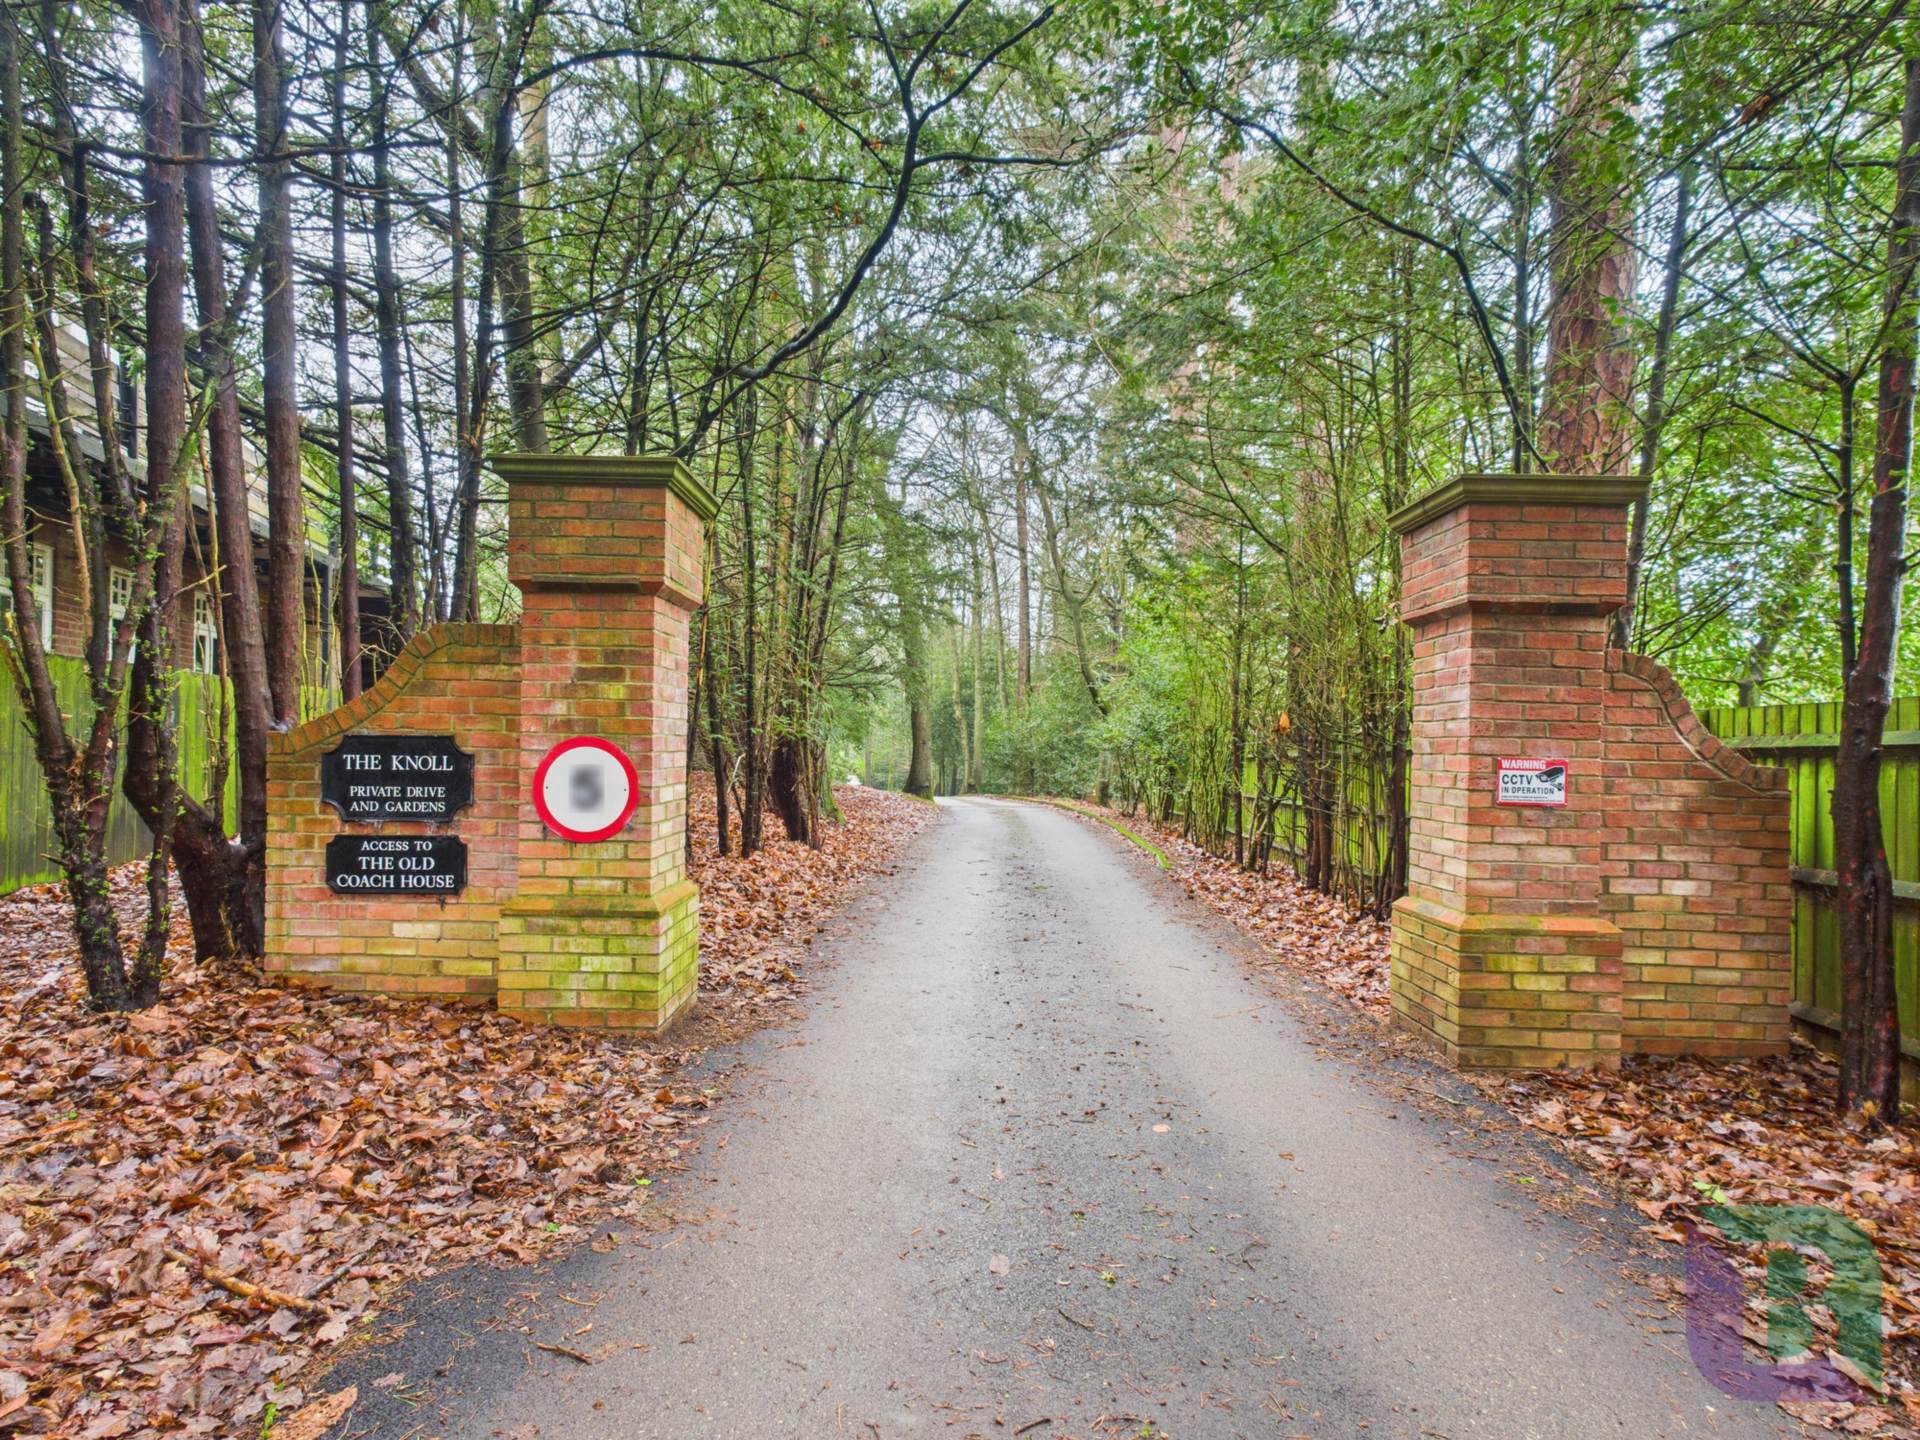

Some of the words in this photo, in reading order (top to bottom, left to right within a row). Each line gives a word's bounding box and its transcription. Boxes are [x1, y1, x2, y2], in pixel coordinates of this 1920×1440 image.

[343, 754, 381, 770] THE
[391, 755, 453, 771] KNOLL
[1501, 759, 1546, 770] WARNING
[1502, 774, 1533, 785] CCTV
[350, 785, 401, 797] PRIVATE
[407, 786, 446, 798] DRIVE
[1511, 786, 1555, 795] OPERATION
[350, 801, 379, 812] AND
[385, 802, 446, 813] GARDENS
[361, 840, 409, 851] ACCESS
[414, 841, 432, 851] TO
[358, 856, 394, 870] THE
[398, 857, 435, 871] OLD
[336, 874, 395, 888] COACH
[400, 875, 455, 888] HOUSE
